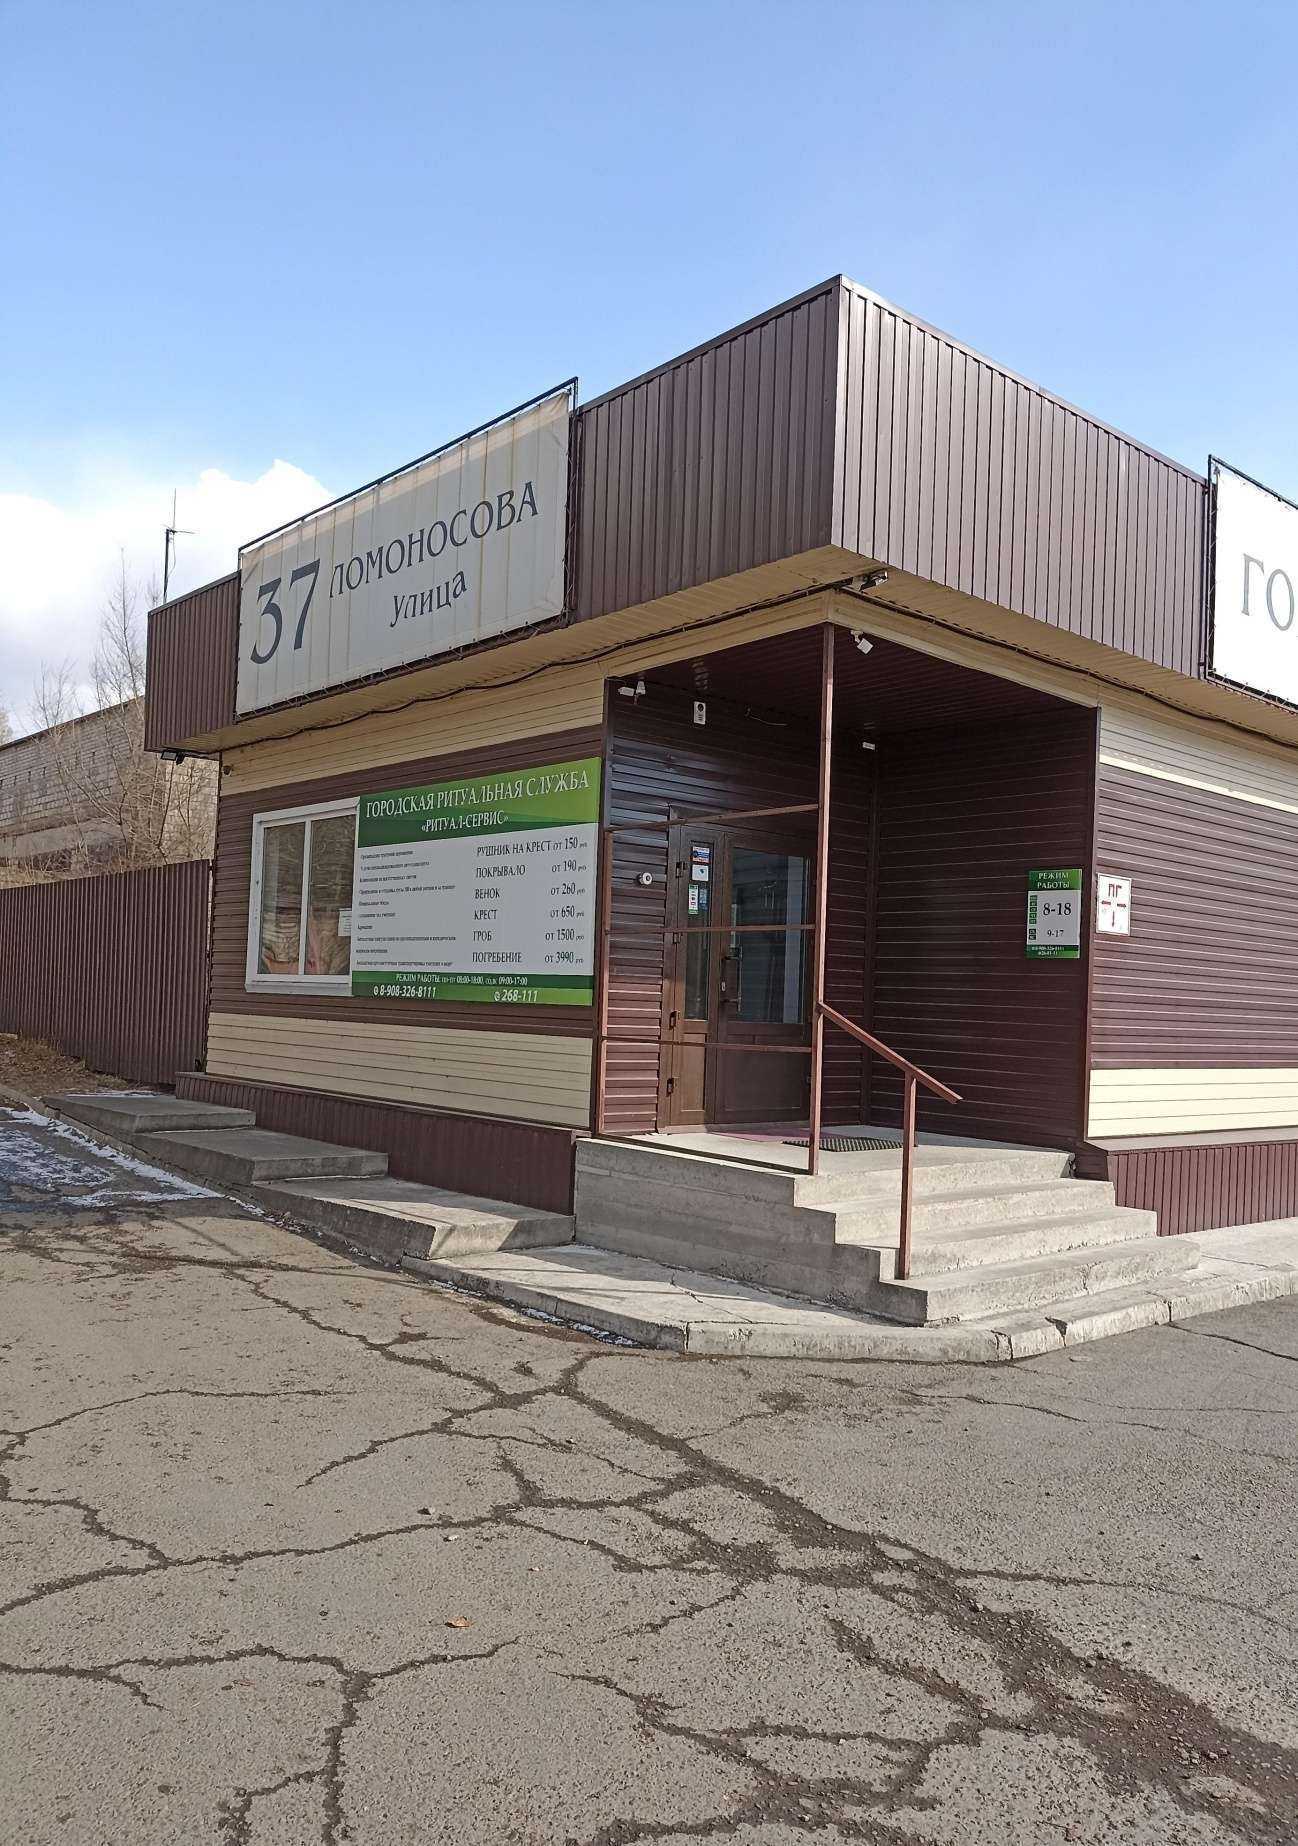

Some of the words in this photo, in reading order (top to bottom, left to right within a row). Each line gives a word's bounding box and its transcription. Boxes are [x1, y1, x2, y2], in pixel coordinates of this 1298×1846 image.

[329, 481, 538, 598] ЛОМОНОСОВА
[390, 570, 467, 627] улица
[250, 558, 321, 664] 37
[366, 793, 434, 818] ГОРОДСКАЯ
[437, 780, 523, 809] РИТУАЛЬНАЯ
[526, 770, 590, 797] СЛУЖБА
[421, 810, 509, 832] «РИТУАЛ-СЕРВИС»
[477, 844, 510, 857] РУШНИК
[512, 843, 524, 854] НА
[526, 840, 551, 853] КРЕСТ
[553, 842, 562, 851] от
[564, 837, 579, 850] 150
[476, 864, 526, 878] ПОКРЫВАЛО
[552, 864, 561, 873] от
[563, 860, 577, 872] 190
[1038, 872, 1069, 880] РЕЖИМ
[475, 887, 501, 899] ВЕНОК
[551, 887, 560, 896] от
[561, 882, 576, 895] 260
[1037, 881, 1070, 889] РАБОТЫ
[474, 909, 498, 920] КРЕСТ
[550, 909, 559, 918] от
[561, 905, 575, 918] 650
[1043, 902, 1072, 916] 8-18
[473, 930, 492, 941] ГРОБ
[545, 932, 555, 941] от
[557, 928, 575, 941] 1500
[1047, 929, 1064, 938] 9-17
[472, 951, 522, 963] ПОГРЕБЕНИЕ
[544, 954, 554, 963] от
[556, 951, 574, 963] 3990
[396, 973, 417, 983] РЕЖИМ
[379, 984, 437, 998] 8-908-326-8111
[501, 988, 539, 1003] 268-111
